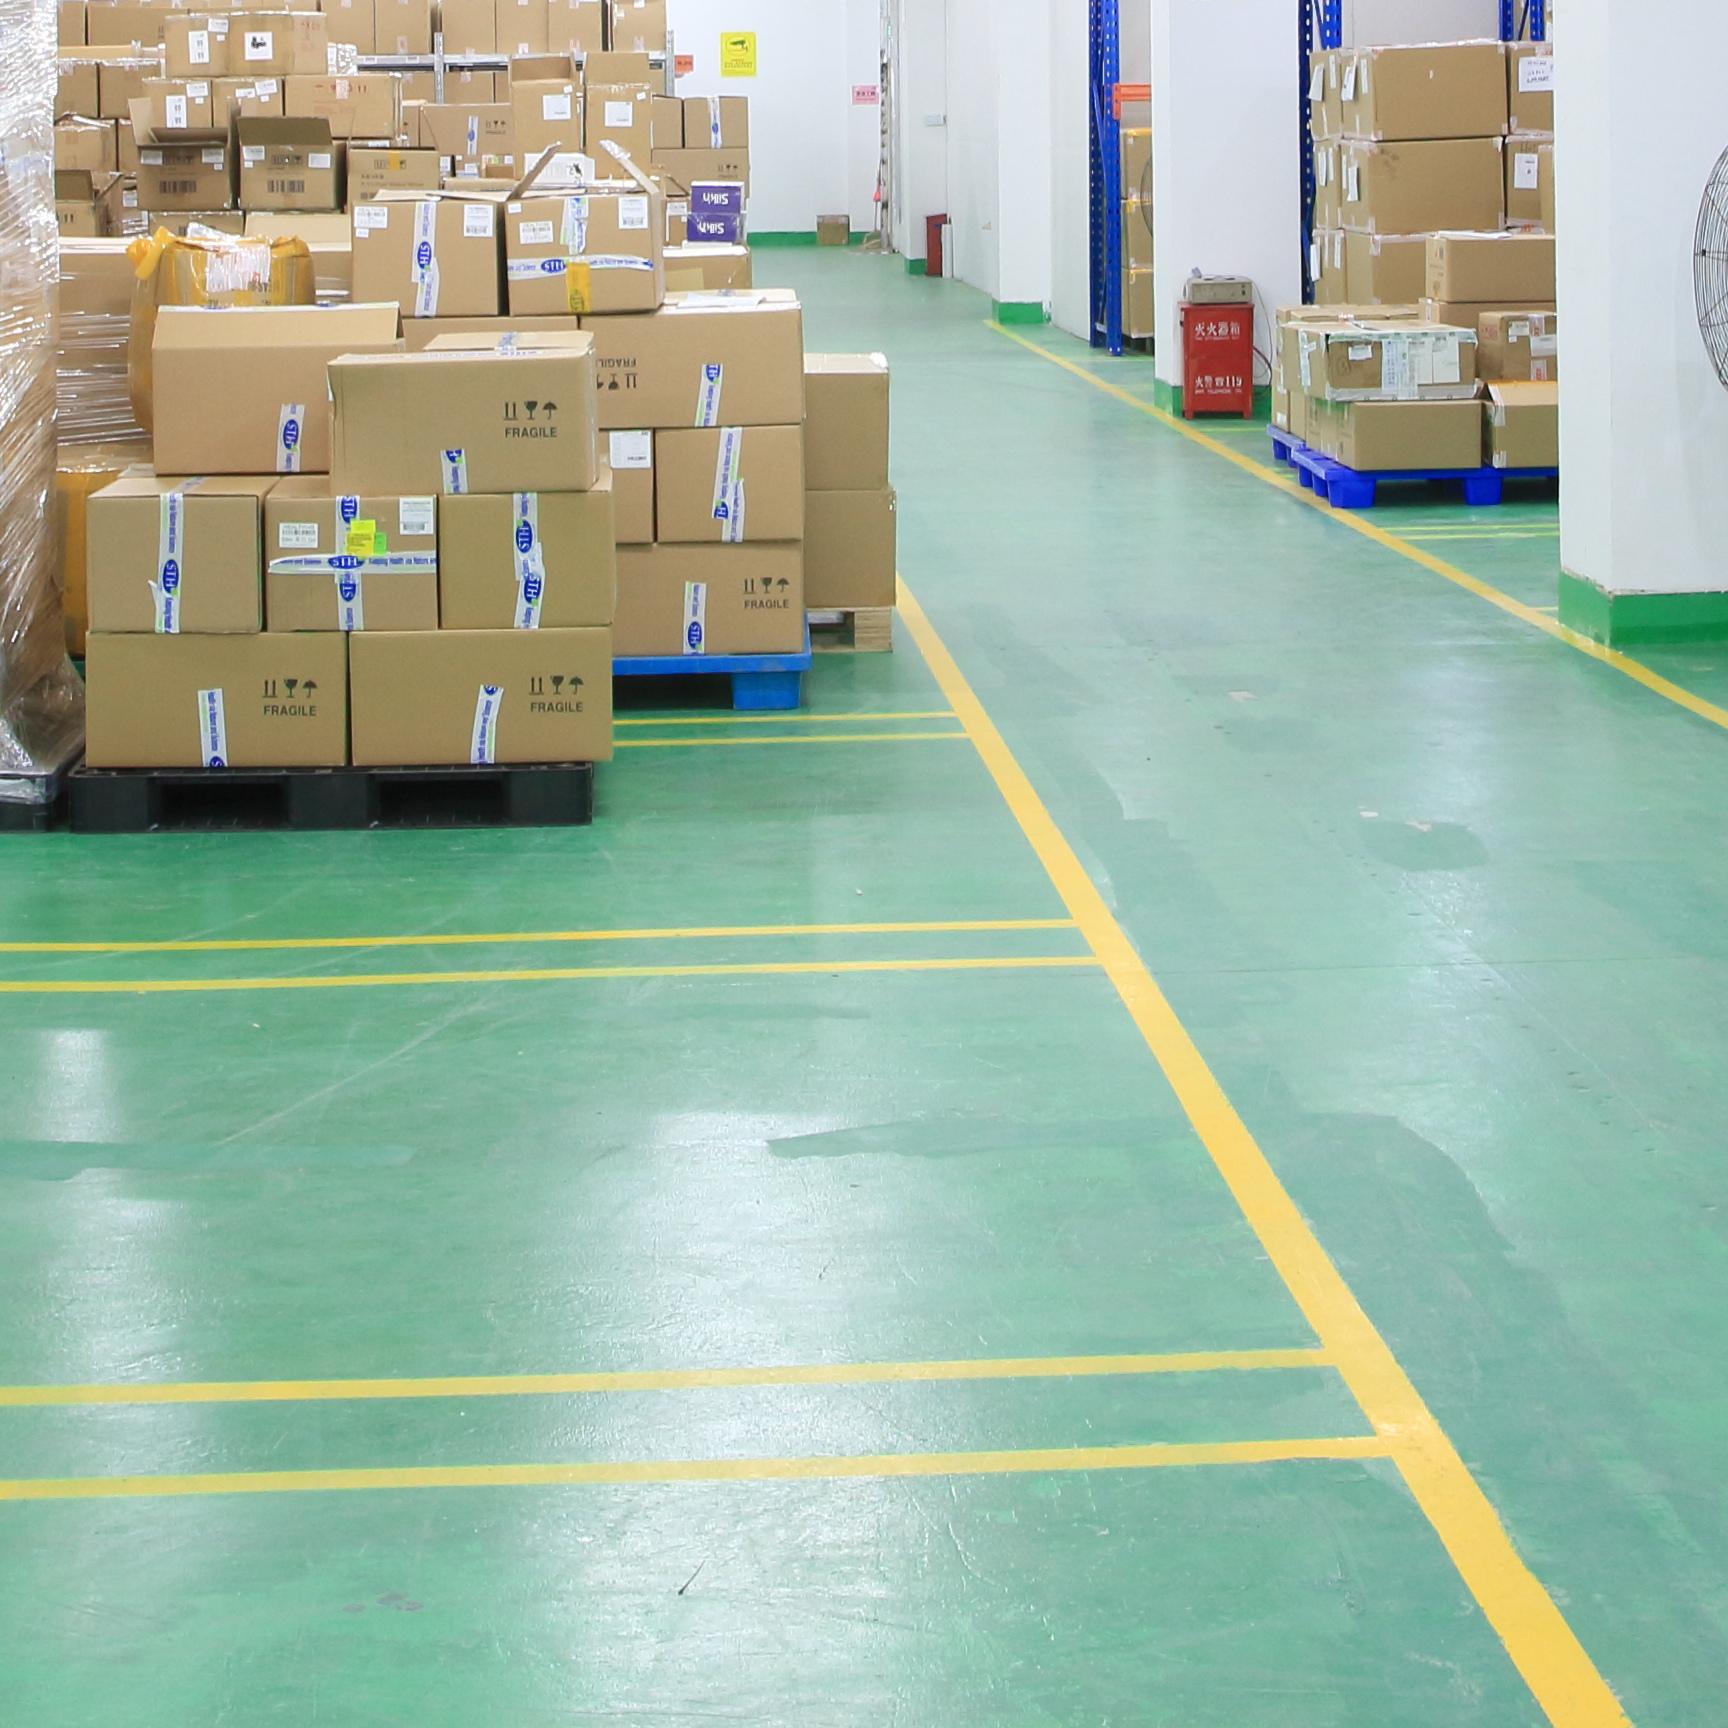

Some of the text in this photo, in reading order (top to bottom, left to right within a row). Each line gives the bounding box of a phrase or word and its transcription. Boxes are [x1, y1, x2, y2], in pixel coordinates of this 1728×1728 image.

[419, 245, 430, 265] STH
[596, 358, 636, 367] FRAGIL
[287, 423, 297, 445] STH
[505, 427, 557, 438] FRAGILE
[342, 496, 356, 518] STH
[518, 525, 530, 550] STH
[332, 557, 359, 566] STH
[166, 563, 176, 588] STH
[526, 576, 540, 599] STH
[744, 600, 789, 608] FRAGILE
[691, 625, 700, 644] STH
[264, 705, 316, 716] FRAGILE
[530, 702, 583, 713] FRAGILE
